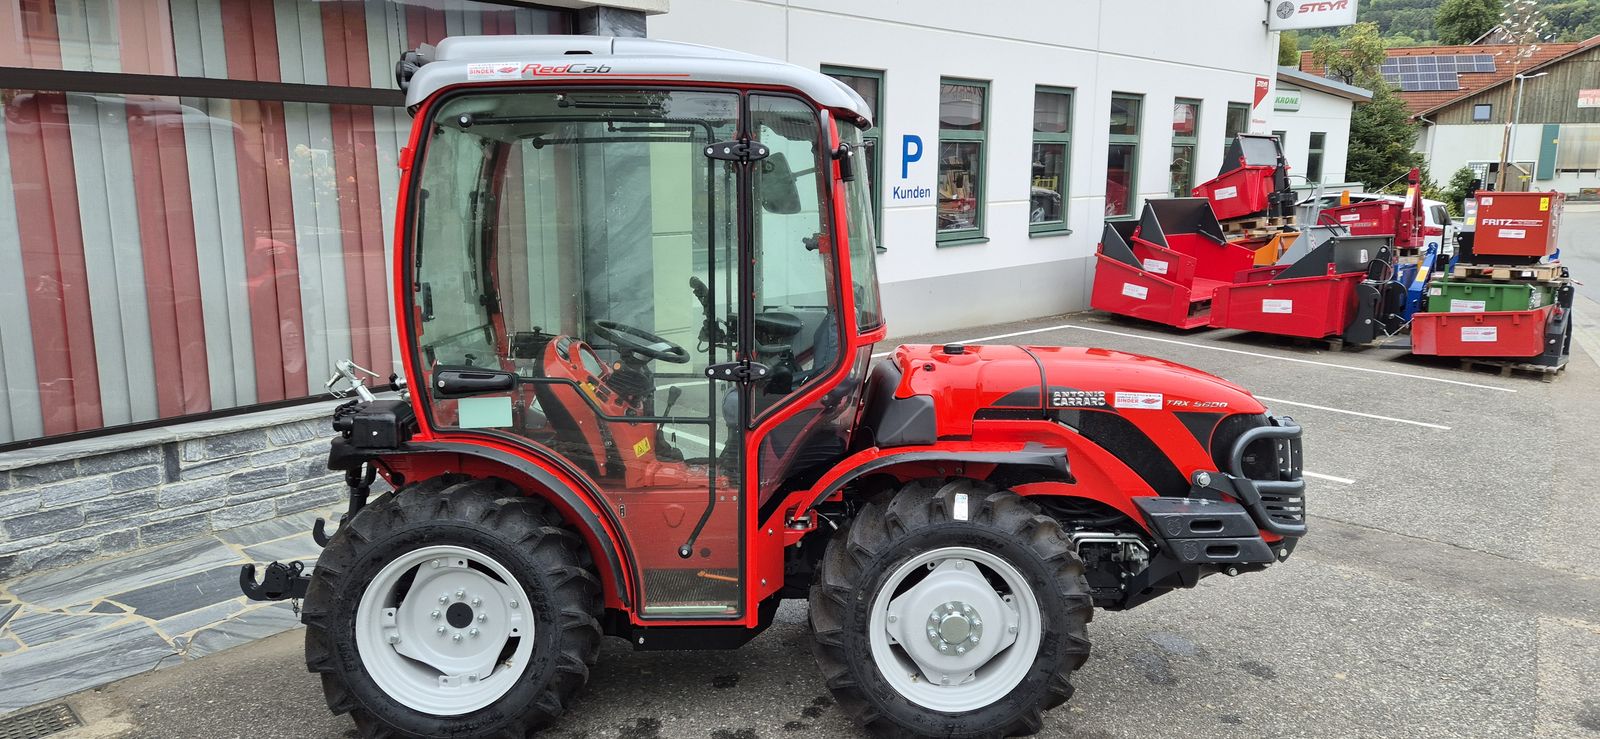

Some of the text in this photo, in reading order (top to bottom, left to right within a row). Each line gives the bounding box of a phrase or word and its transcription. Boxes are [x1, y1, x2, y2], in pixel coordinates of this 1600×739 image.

[1298, 0, 1348, 13] STEYR
[521, 63, 612, 75] RedCab
[1275, 96, 1299, 104] KRONE
[902, 134, 923, 179] P
[893, 186, 931, 199] Kunden
[1482, 218, 1513, 226] FRITZ
[1053, 398, 1106, 406] CARRARO
[1166, 399, 1189, 407] TRX
